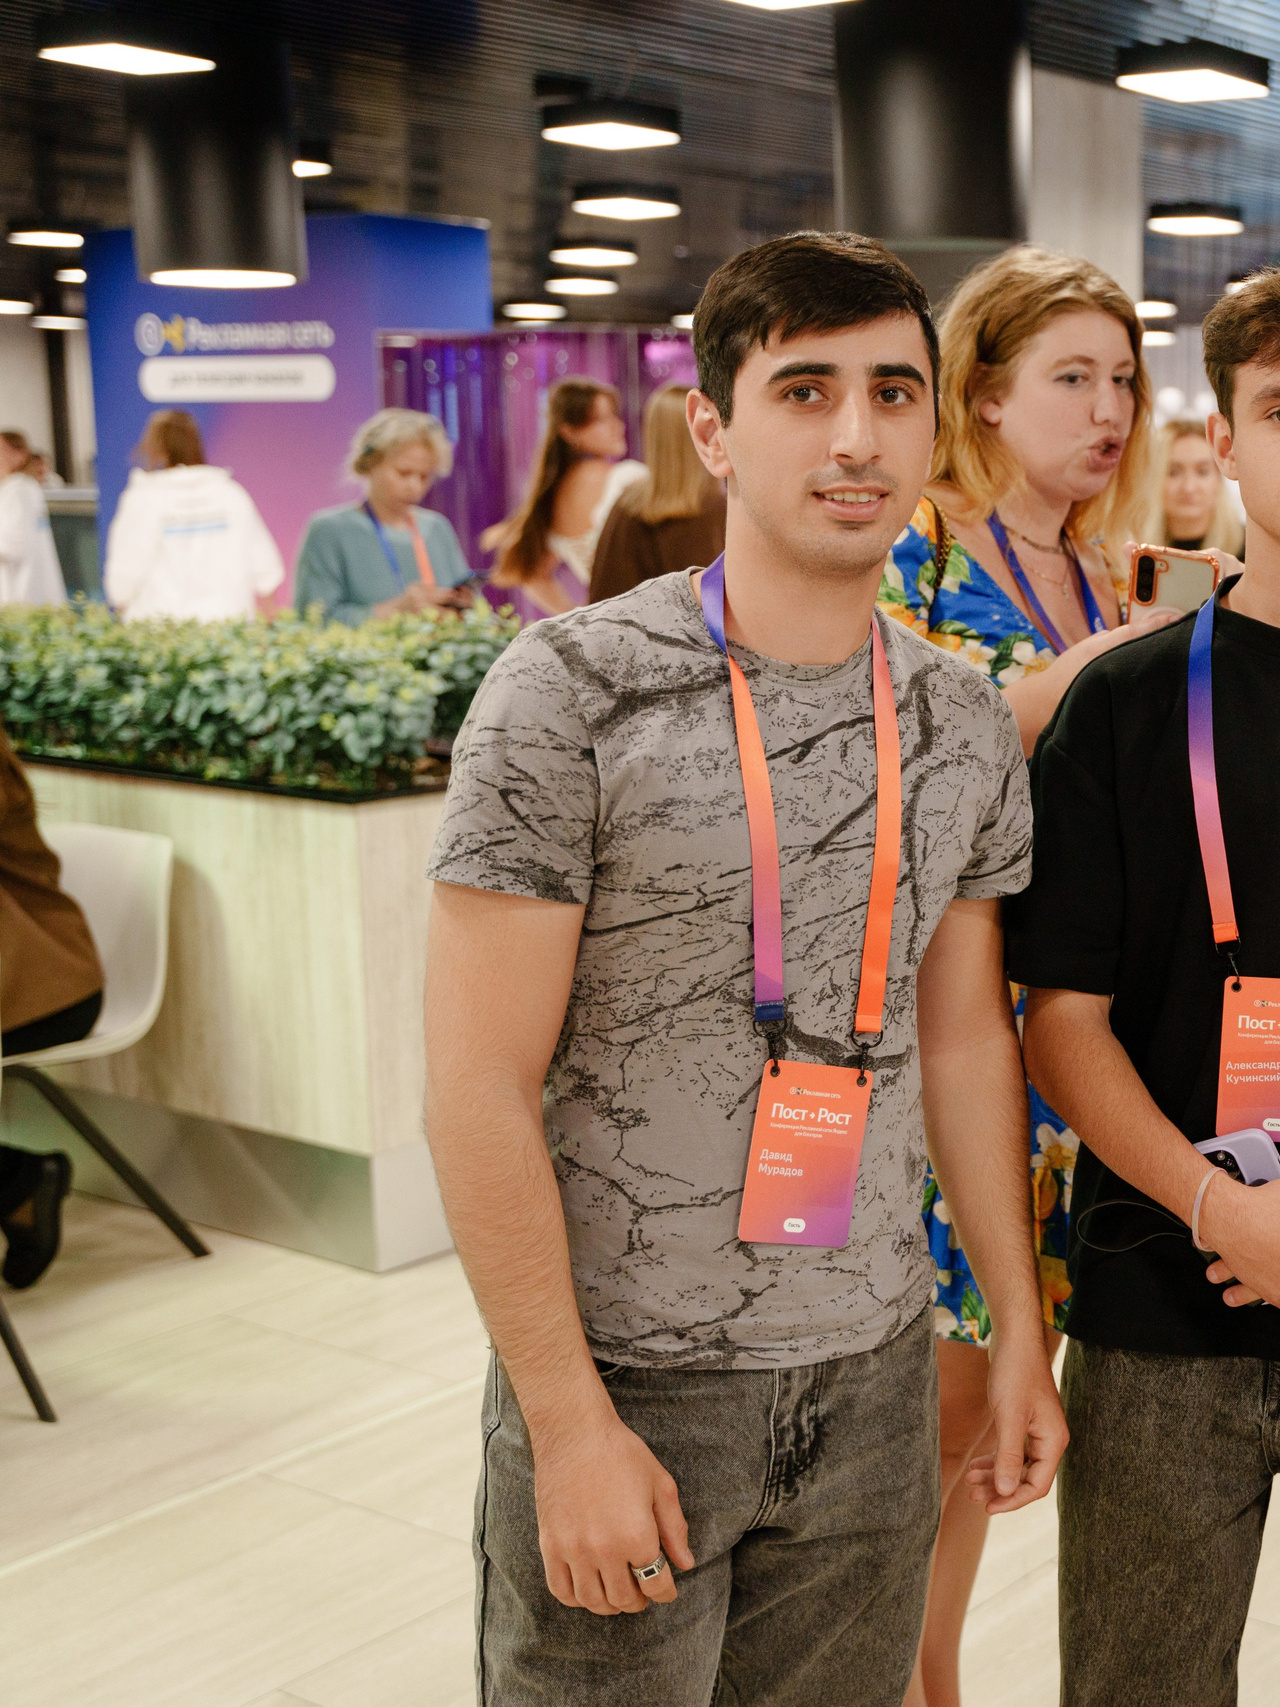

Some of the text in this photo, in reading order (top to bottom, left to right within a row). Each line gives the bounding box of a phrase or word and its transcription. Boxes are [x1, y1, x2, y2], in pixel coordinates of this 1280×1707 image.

[1238, 1015, 1276, 1030] Пост
[803, 1089, 841, 1099] Рекламная сеть
[771, 1103, 852, 1125] Пост Рост
[760, 1149, 793, 1163] Давид
[758, 1163, 804, 1177] Мурадов
